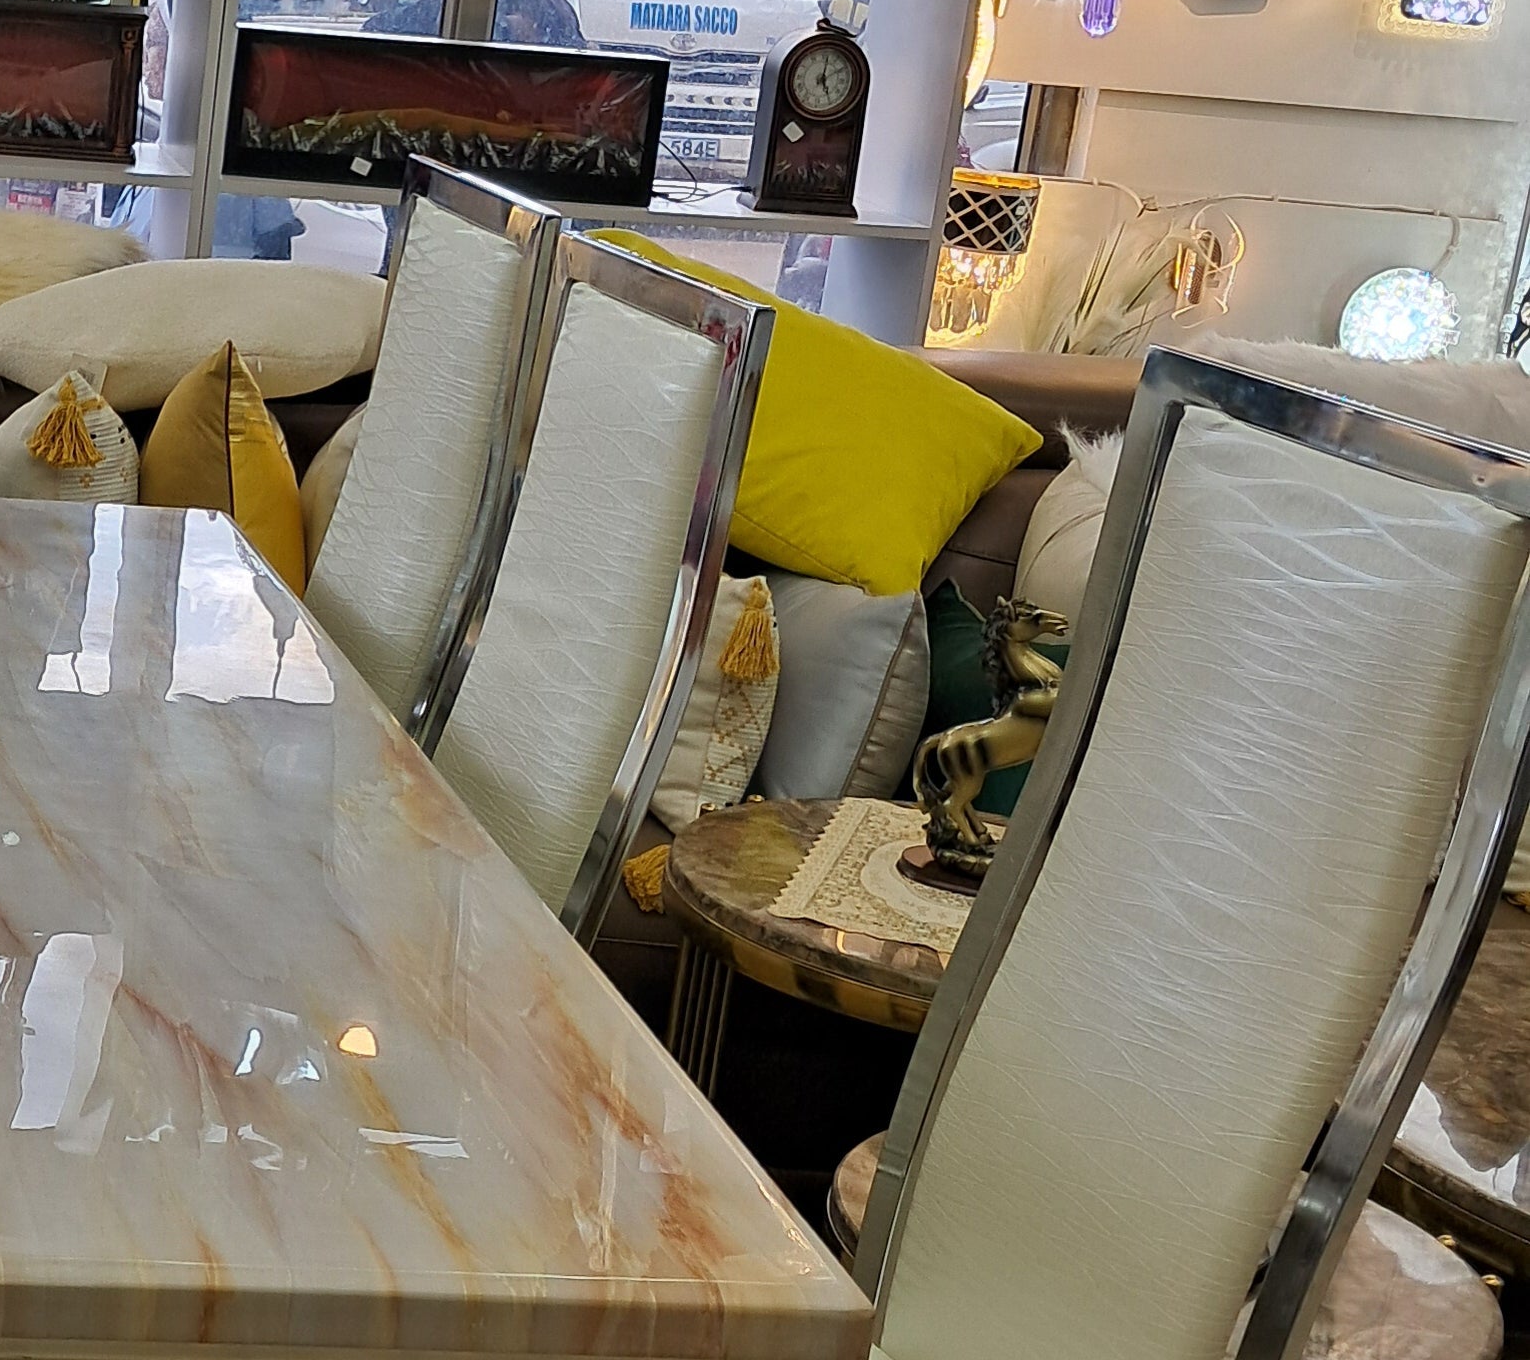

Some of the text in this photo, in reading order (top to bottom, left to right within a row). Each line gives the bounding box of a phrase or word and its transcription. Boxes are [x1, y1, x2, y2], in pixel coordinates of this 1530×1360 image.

[630, 2, 738, 36] MATAARA SACCO
[671, 140, 717, 158] 584E
